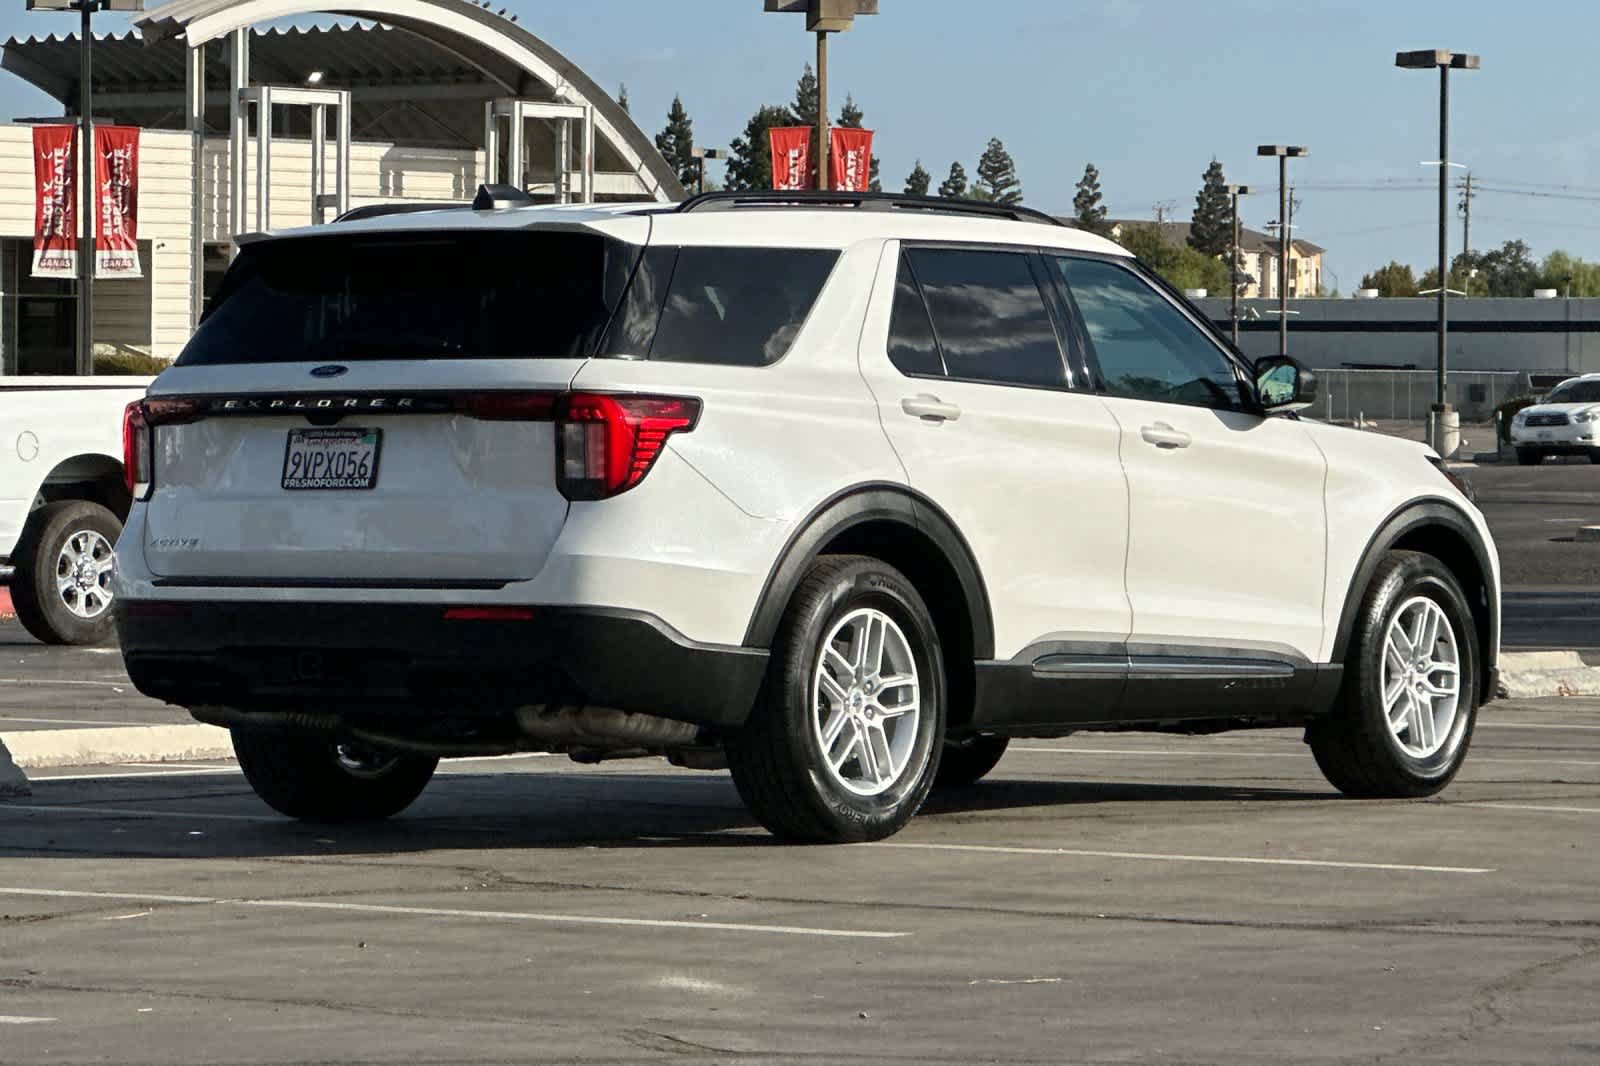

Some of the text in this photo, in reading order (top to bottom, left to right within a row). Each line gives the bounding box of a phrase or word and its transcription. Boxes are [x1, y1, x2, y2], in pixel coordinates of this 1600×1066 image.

[224, 399, 412, 409] EXPLORER
[290, 451, 370, 478] 9VPX056
[283, 478, 369, 488] FRESNOFORD.COM
